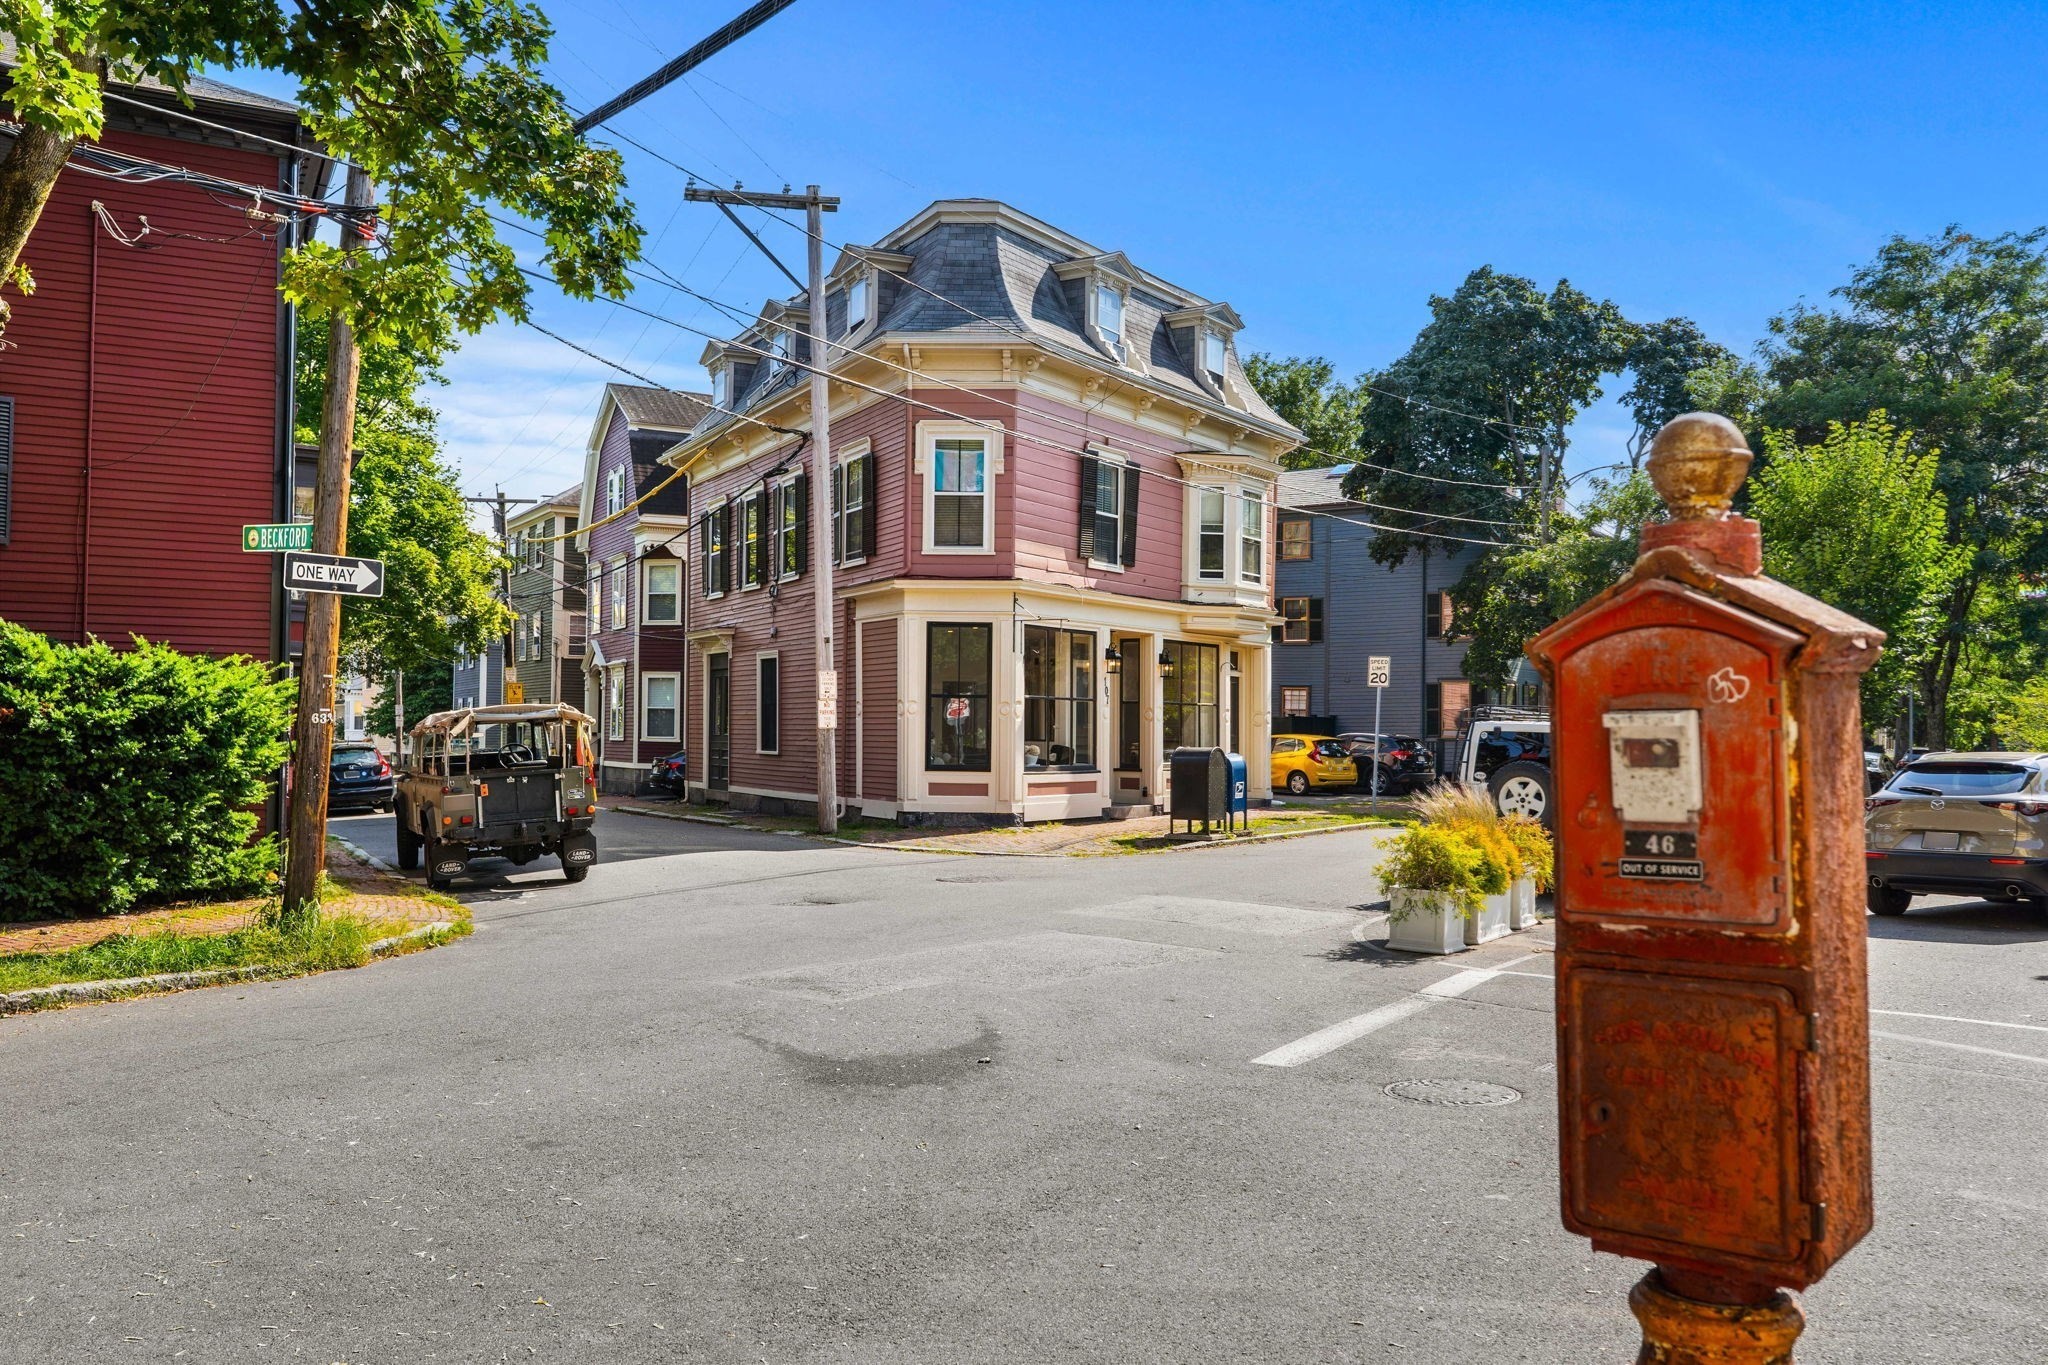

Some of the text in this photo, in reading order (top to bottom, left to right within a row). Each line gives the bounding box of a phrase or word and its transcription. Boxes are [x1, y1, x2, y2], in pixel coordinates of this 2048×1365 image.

[260, 528, 308, 548] BECKFORD
[296, 564, 356, 582] ONE WAY
[1370, 672, 1387, 683] 20
[1644, 834, 1675, 854] 46
[1622, 863, 1699, 876] OUT OF SERVICE
